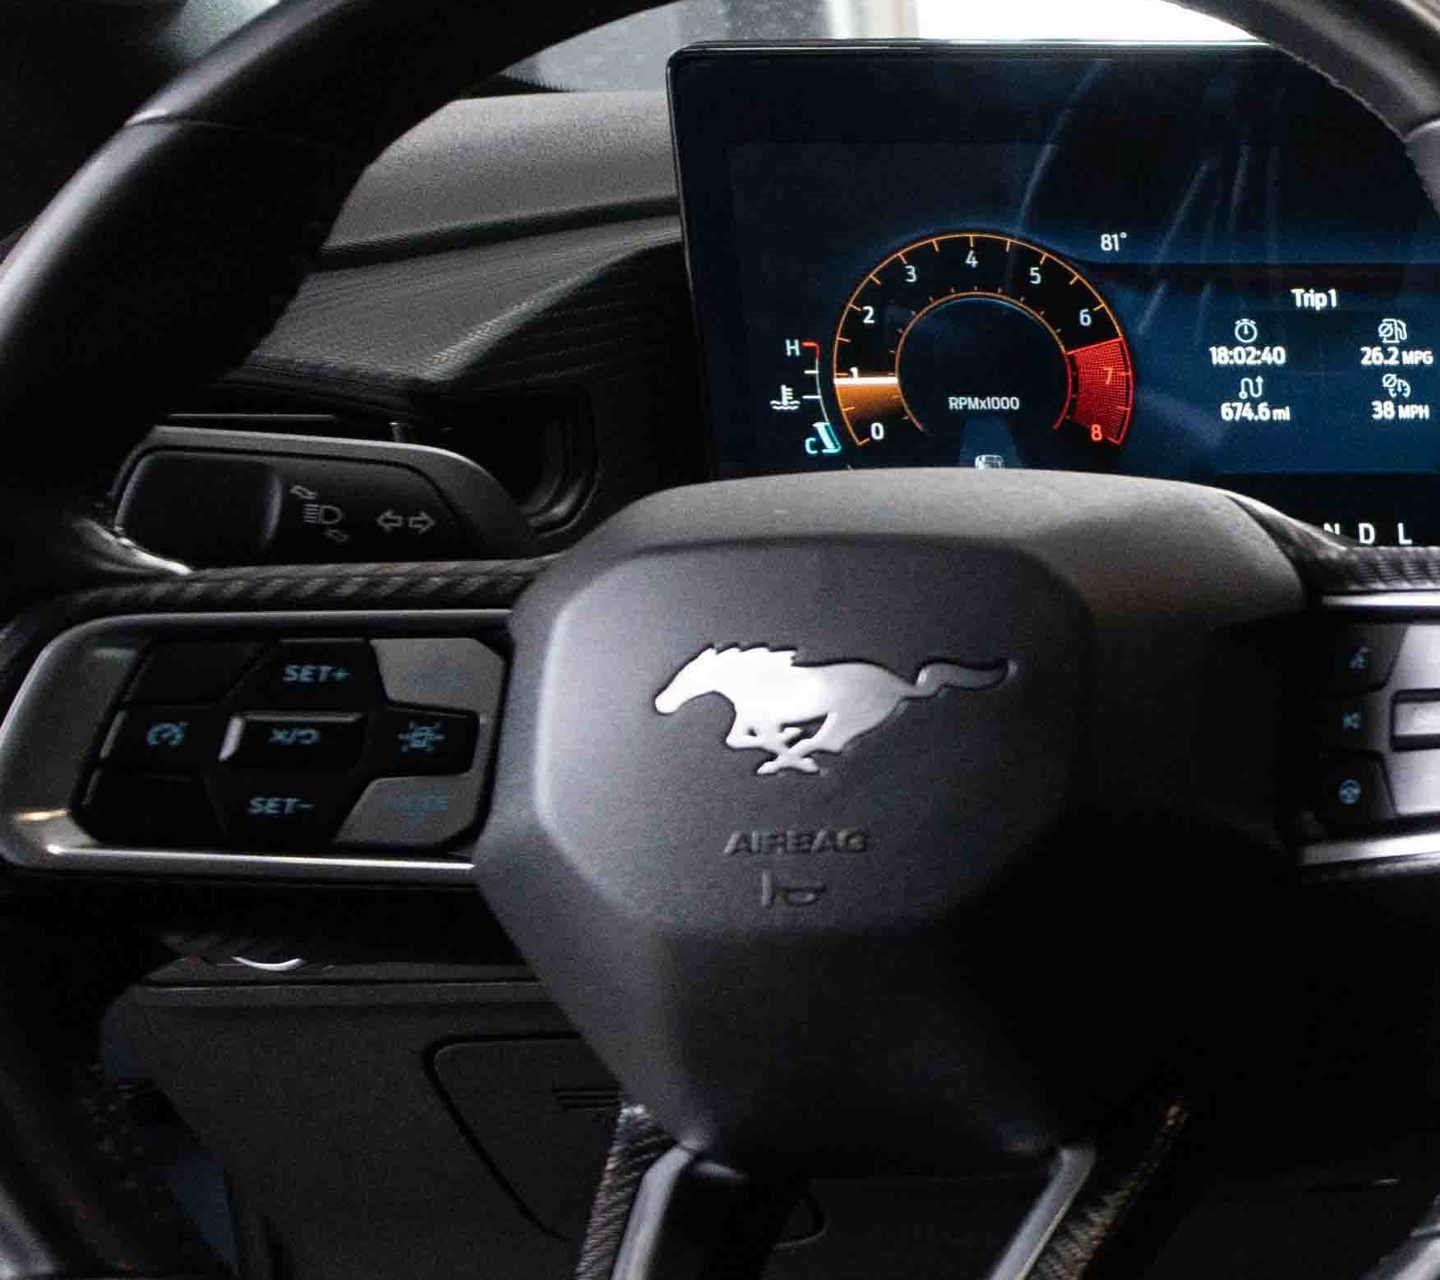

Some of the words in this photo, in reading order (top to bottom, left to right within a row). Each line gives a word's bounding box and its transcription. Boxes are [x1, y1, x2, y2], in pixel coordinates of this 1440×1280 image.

[1100, 231, 1128, 252] 81°
[965, 250, 979, 268] 4
[904, 265, 917, 283] 3
[1029, 266, 1042, 285] 5
[1290, 288, 1328, 311] Trip
[1328, 288, 1338, 308] 1
[861, 306, 875, 324] 2
[1079, 308, 1092, 327] 6
[785, 339, 801, 357] H
[1208, 345, 1286, 366] 18:02:40
[1360, 346, 1400, 366] 26.2
[1402, 350, 1434, 365] MPG
[948, 396, 1020, 410] RPMx1000
[1220, 401, 1271, 422] 674.6
[1272, 405, 1291, 421] mi
[1371, 400, 1396, 420] 38
[1397, 404, 1430, 420] MPH
[870, 422, 885, 441] 0
[1091, 423, 1103, 441] 8
[1358, 522, 1376, 545] D
[1397, 522, 1413, 545] L
[283, 664, 351, 683] SET+
[722, 828, 871, 855] AIRBAG
